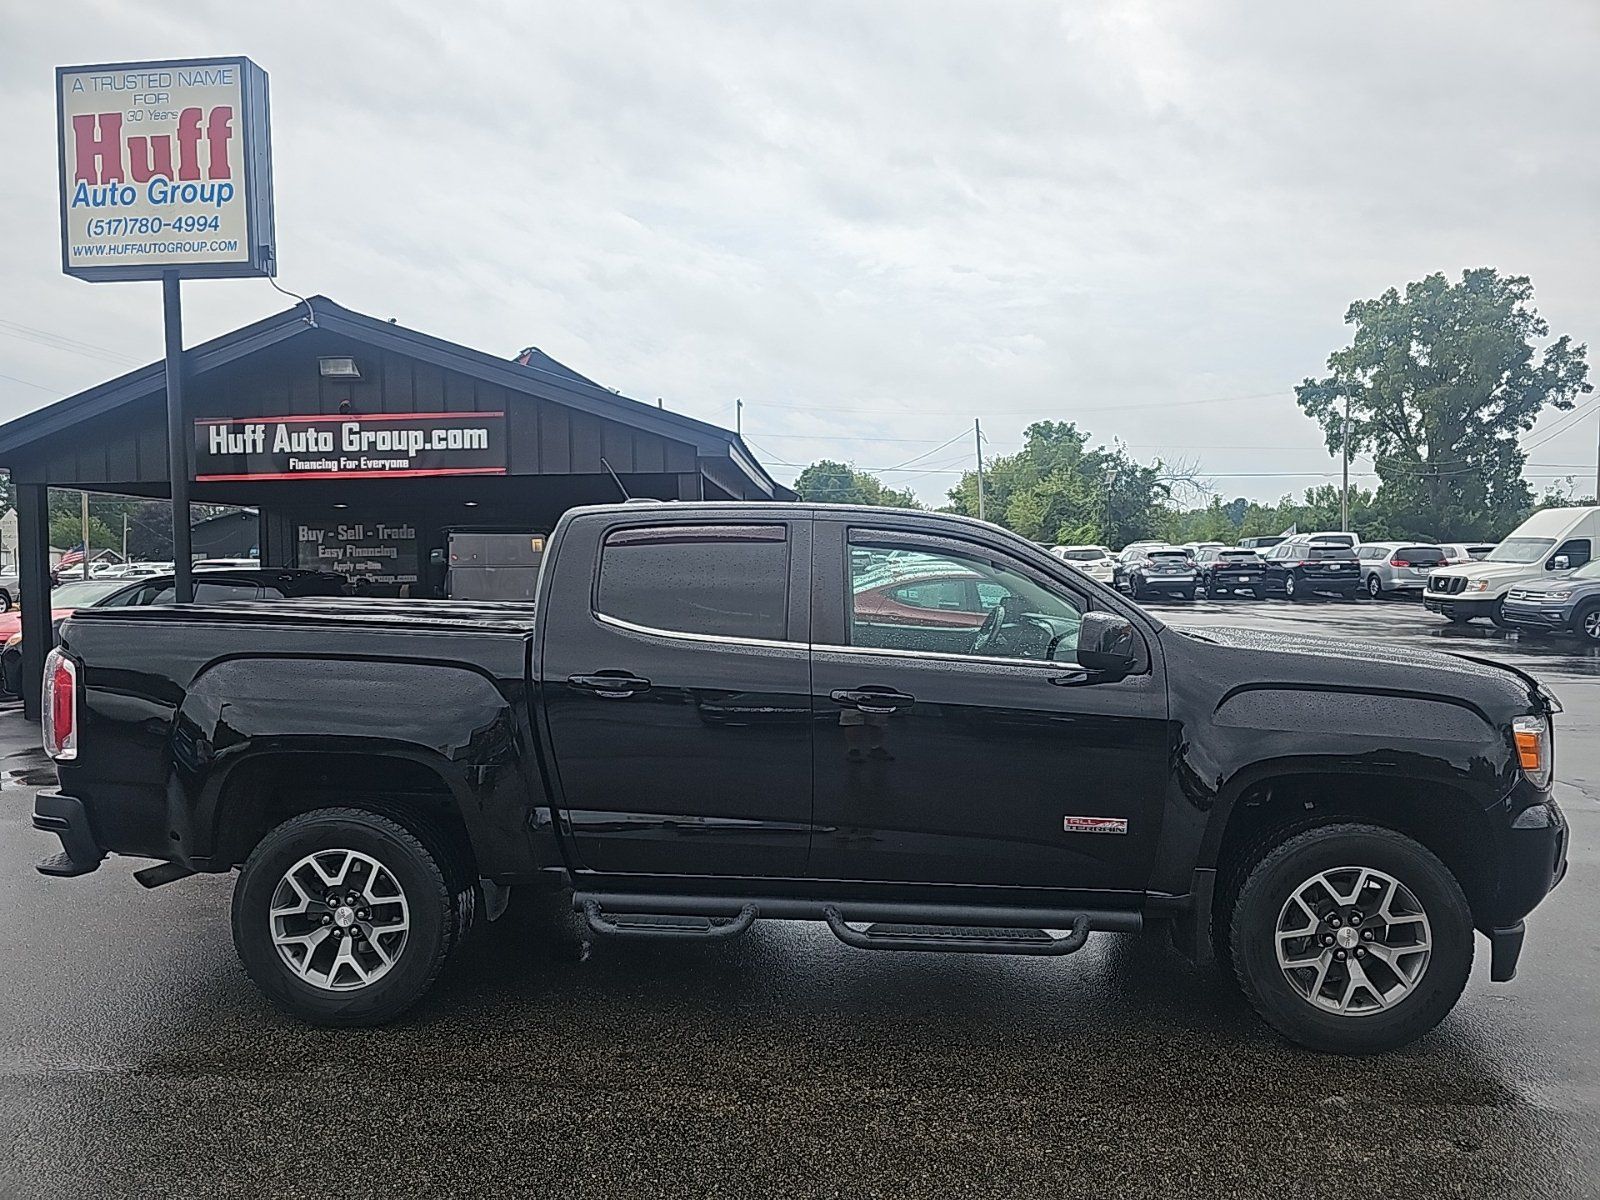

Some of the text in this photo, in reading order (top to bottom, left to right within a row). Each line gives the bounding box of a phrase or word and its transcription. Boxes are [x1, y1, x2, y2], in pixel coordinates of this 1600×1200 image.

[72, 69, 233, 93] A TRUSTED NAME
[133, 93, 169, 105] FOR
[127, 110, 178, 122] 30 Years
[72, 106, 233, 186] Huff
[72, 178, 234, 208] Auto Group
[87, 216, 219, 237] (517)780-4994
[73, 240, 237, 256] WWW.HUFFAUTOGROUP.COM
[209, 422, 488, 457] Huff Auto Group.com
[289, 456, 409, 472] Financing For Everyone
[298, 525, 325, 544] Buy
[337, 524, 364, 541] Sell
[376, 523, 416, 540] Trade
[318, 544, 398, 560] Easy Financing
[333, 561, 354, 572] Apply
